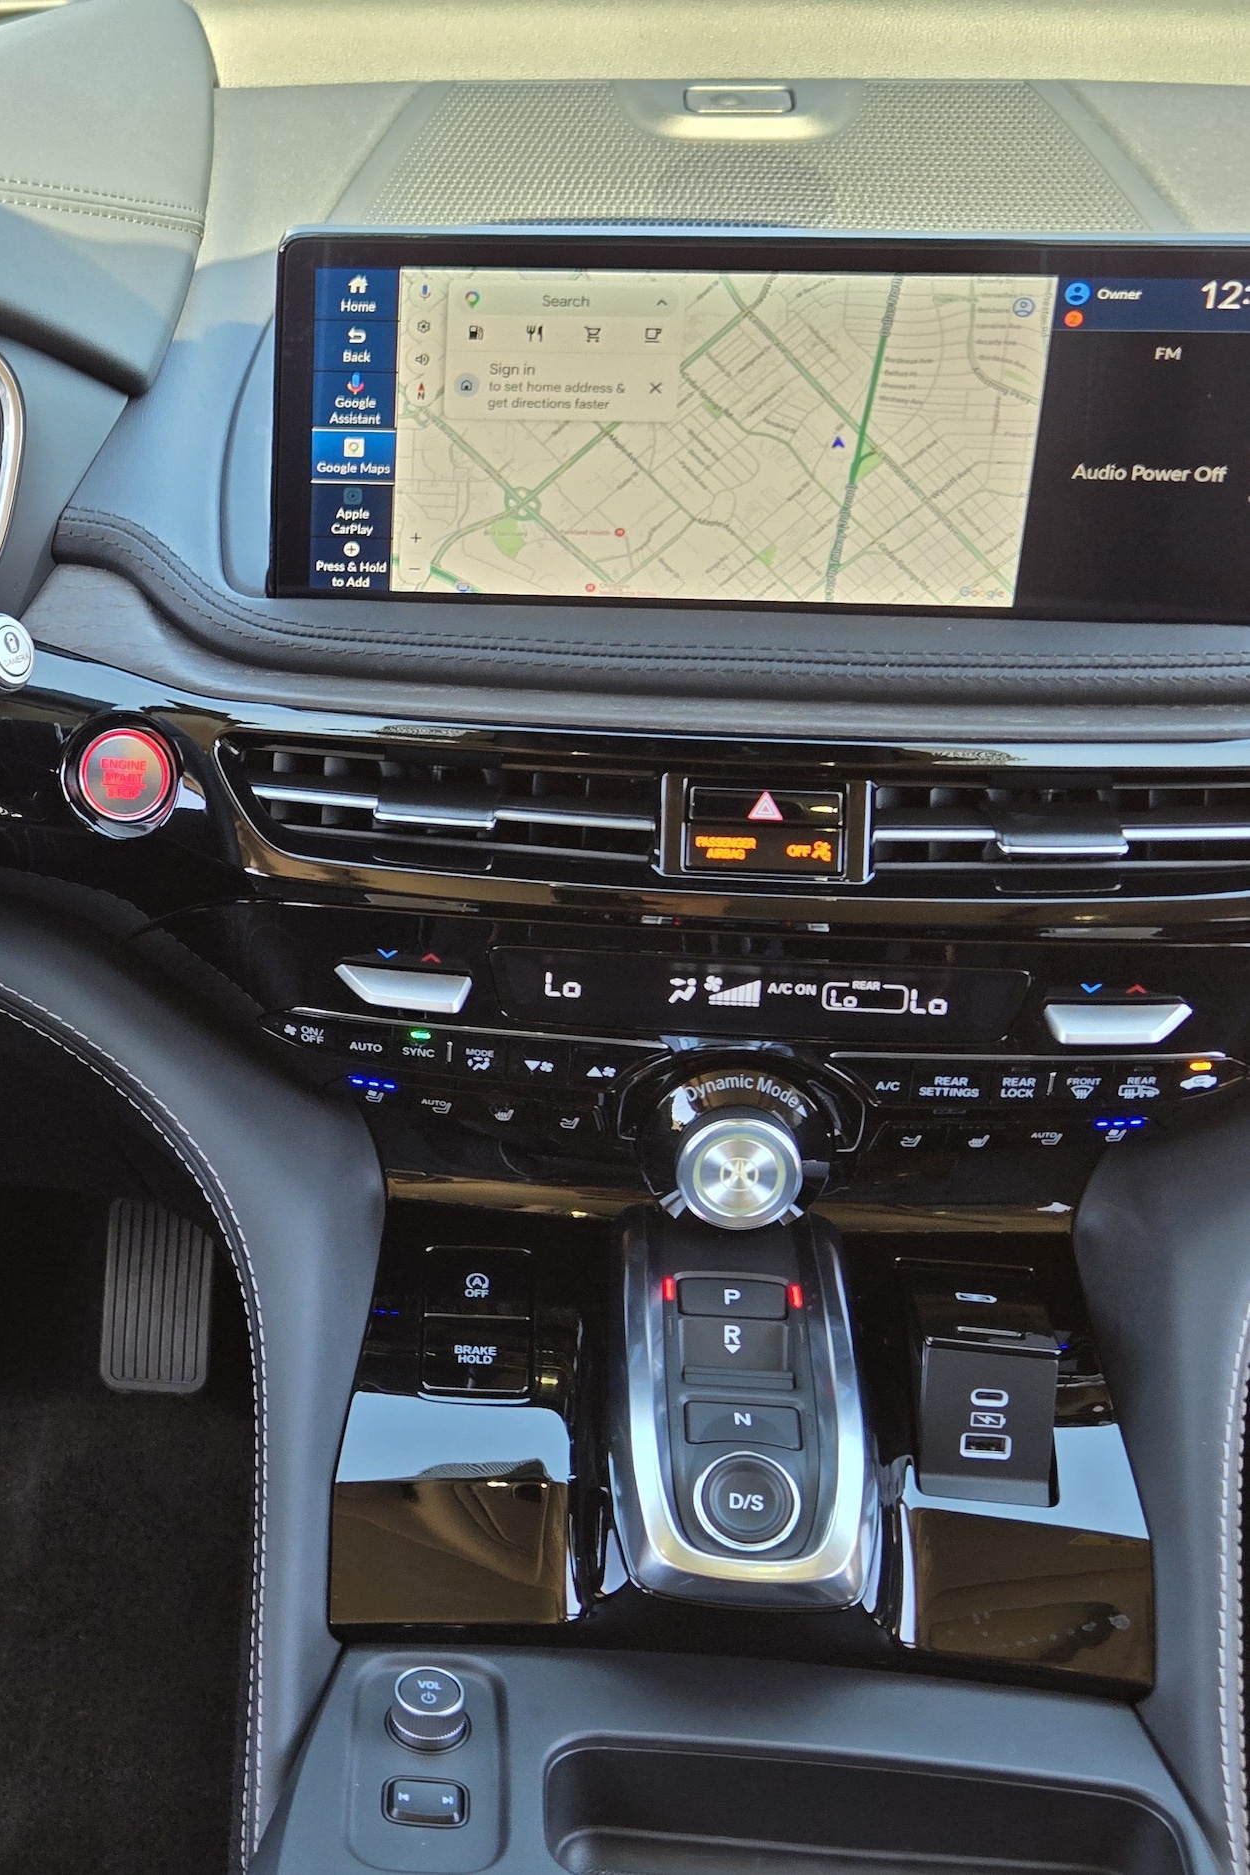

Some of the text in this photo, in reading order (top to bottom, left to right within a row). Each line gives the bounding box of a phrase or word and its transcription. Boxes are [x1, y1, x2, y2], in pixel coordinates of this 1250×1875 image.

[1097, 287, 1143, 300] Owner
[340, 299, 376, 313] Home
[542, 295, 590, 309] Search
[342, 350, 371, 364] Back
[1154, 346, 1182, 360] FM
[489, 363, 536, 378] Sign in
[489, 382, 625, 394] to set home address &
[417, 391, 425, 400] N
[334, 396, 376, 411] Google
[487, 398, 610, 411] get directions faster
[329, 412, 381, 425] Assistant
[316, 462, 390, 477] Google Maps
[1071, 463, 1228, 483] Audio Power Off
[335, 508, 370, 521] Apple
[331, 523, 373, 538] CarPlay
[316, 560, 387, 574] Press & Hold
[331, 576, 370, 588] to Add
[959, 586, 1005, 599] Google
[100, 758, 148, 771] ENGINE
[104, 772, 144, 783] START
[695, 836, 757, 849] PASSENGER
[706, 848, 746, 860] AIRBAG
[786, 845, 811, 857] OFF
[545, 972, 581, 998] Lo
[767, 982, 817, 996] A/C ON
[852, 980, 881, 991] REAR
[830, 989, 858, 1008] Lo
[910, 989, 948, 1015] Lo
[301, 1025, 324, 1037] ON/
[301, 1033, 324, 1044] OFF
[349, 1041, 382, 1053] AUTO
[402, 1046, 435, 1058] SYNC
[466, 1048, 494, 1058] MODE
[875, 1081, 900, 1092] A/C
[934, 1076, 968, 1087] REAR
[1002, 1077, 1036, 1088] REAR
[1067, 1077, 1101, 1086] FRONT
[1127, 1076, 1156, 1085] REAR
[684, 1073, 800, 1109] Dynamic Mode
[919, 1086, 979, 1098] SETTINGS
[1001, 1087, 1034, 1098] LOCK
[421, 1098, 447, 1107] AUTO
[1031, 1132, 1057, 1141] AUTO
[464, 1288, 489, 1298] OFF
[724, 1289, 741, 1305] P
[724, 1325, 741, 1344] R
[454, 1344, 497, 1356] BRAKE
[457, 1354, 493, 1365] HOLD
[734, 1412, 751, 1426] N
[729, 1492, 764, 1511] D/S
[418, 1680, 441, 1690] VOL
